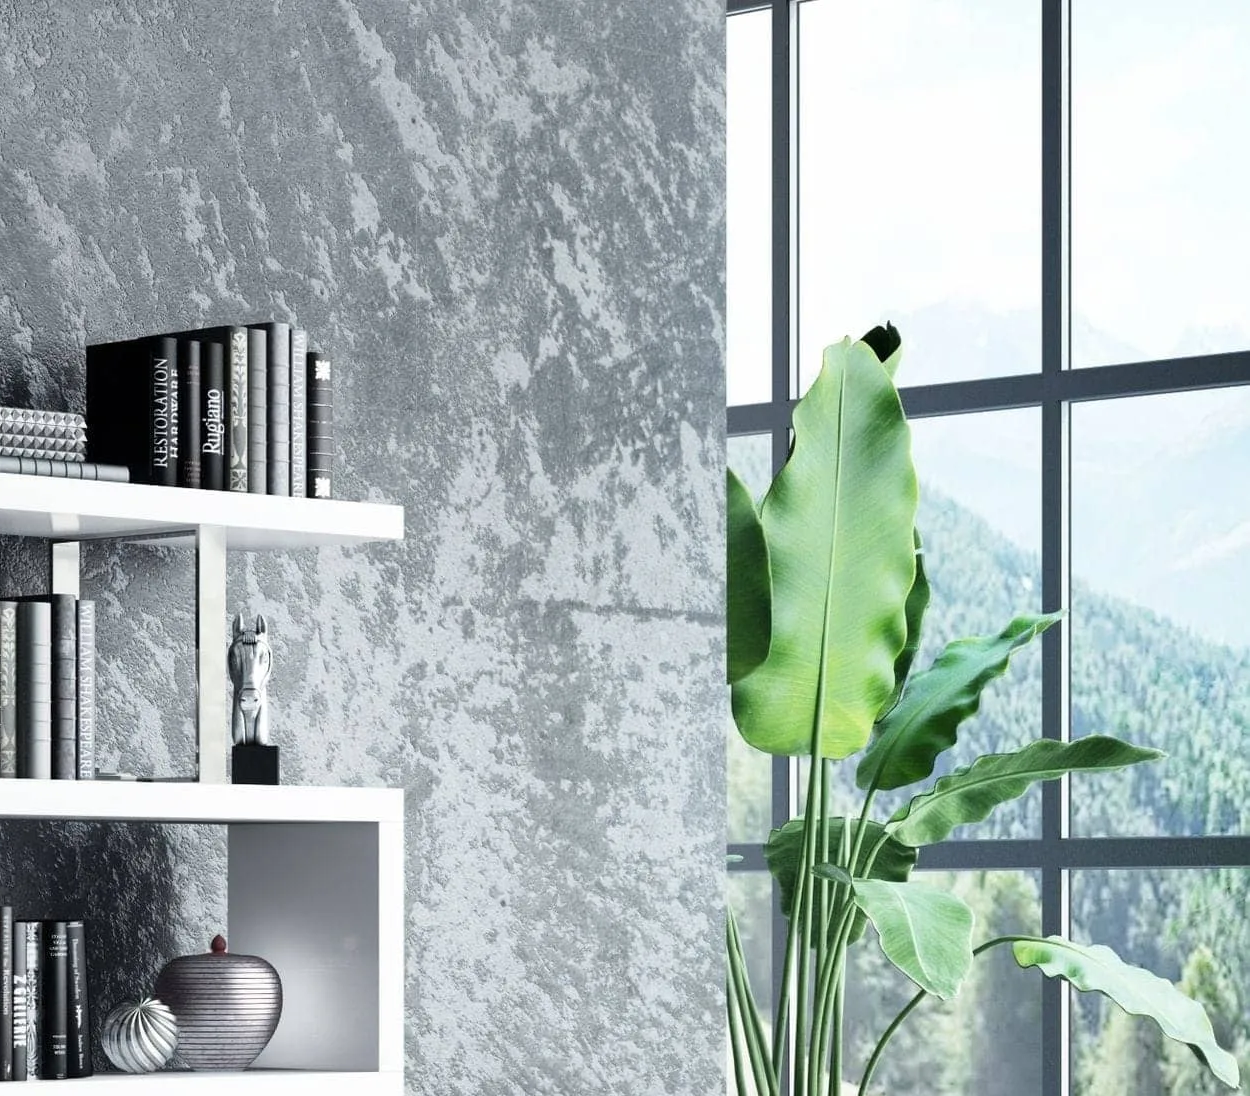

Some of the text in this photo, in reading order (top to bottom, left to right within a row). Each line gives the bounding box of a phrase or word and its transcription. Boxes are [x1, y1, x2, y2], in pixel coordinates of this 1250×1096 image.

[293, 333, 304, 397] WILLIAM
[153, 358, 168, 468] RESTORATION
[202, 389, 224, 455] Rugiano
[80, 604, 92, 778] WILLIAM SHAKESPEARE
[13, 975, 26, 984] Z
